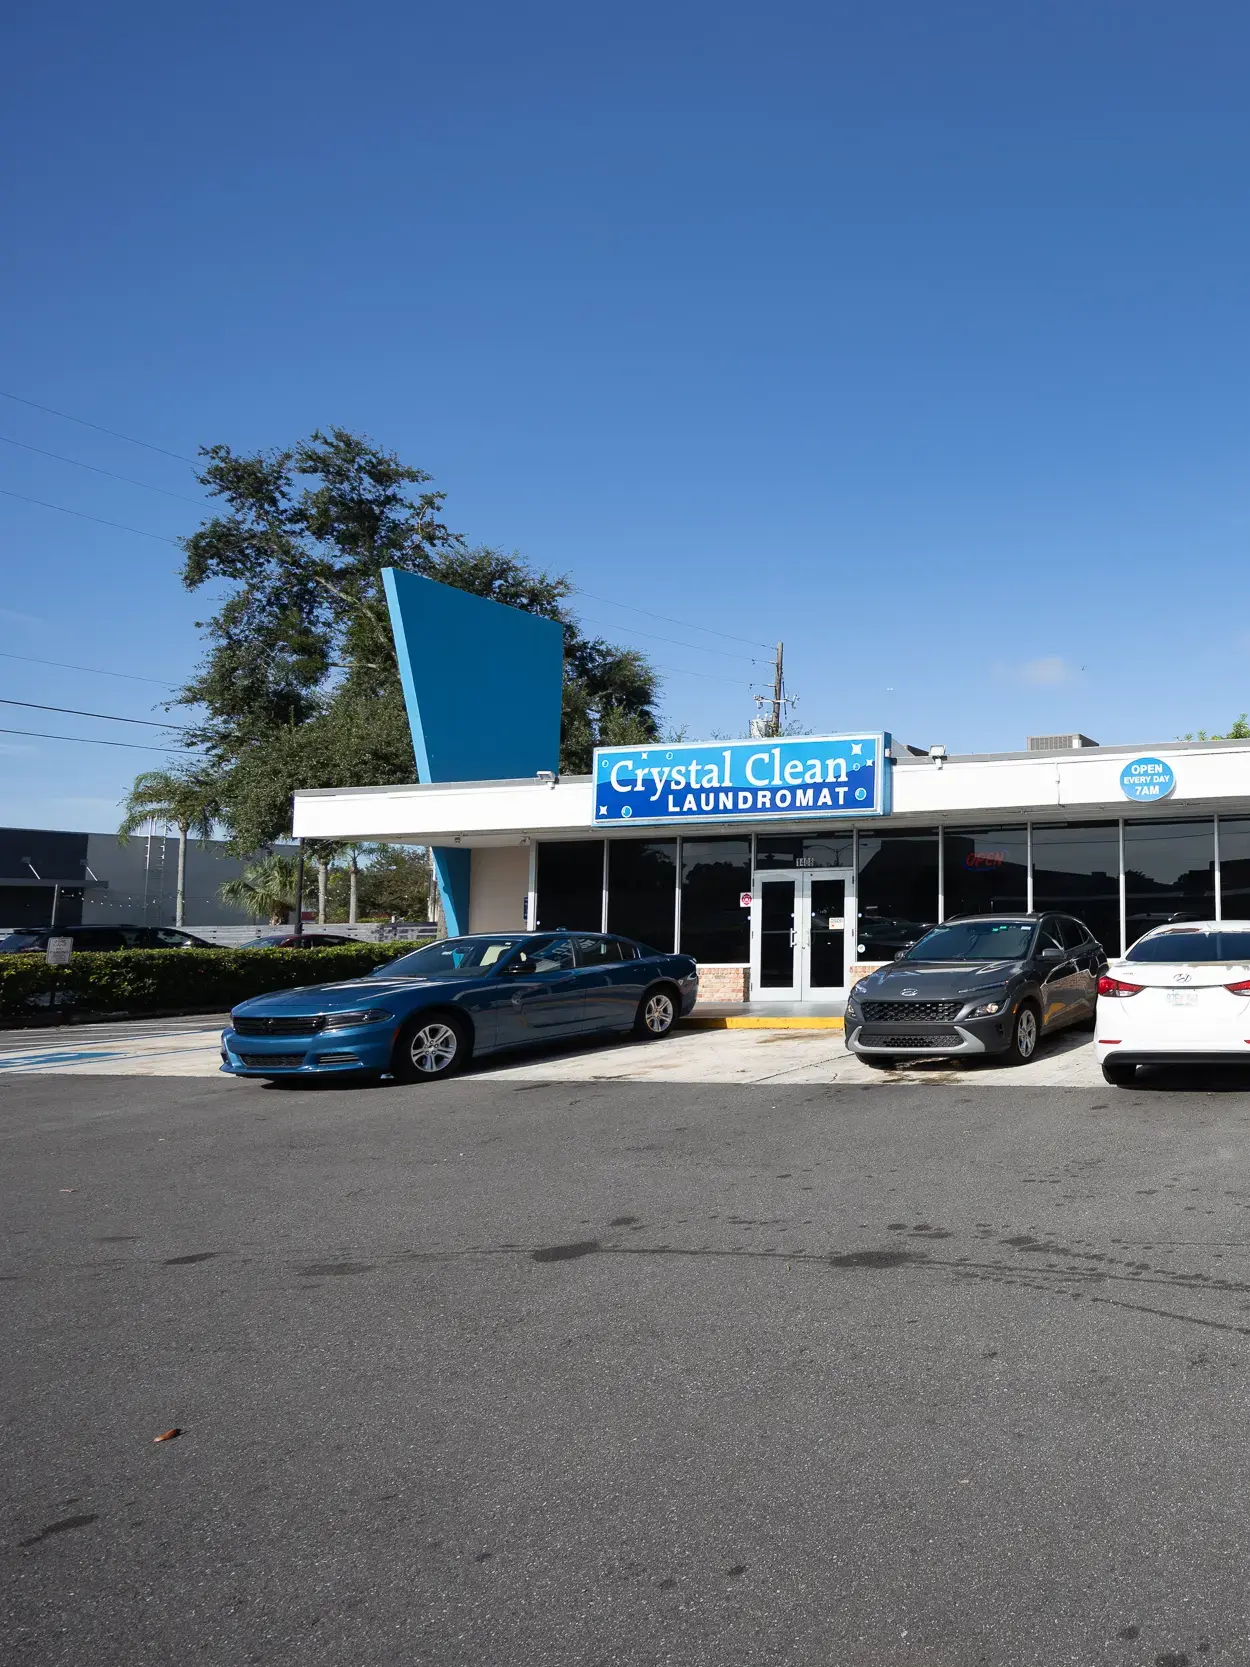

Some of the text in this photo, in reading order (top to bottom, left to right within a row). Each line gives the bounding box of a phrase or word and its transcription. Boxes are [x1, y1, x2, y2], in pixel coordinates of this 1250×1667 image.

[610, 747, 848, 801] Crystal Clean
[1131, 764, 1162, 774] OPEN
[1124, 775, 1170, 784] EVERY DAY
[1135, 786, 1159, 795] 7AM
[668, 786, 849, 812] LAUNDROMAT
[965, 852, 1004, 867] OPEN
